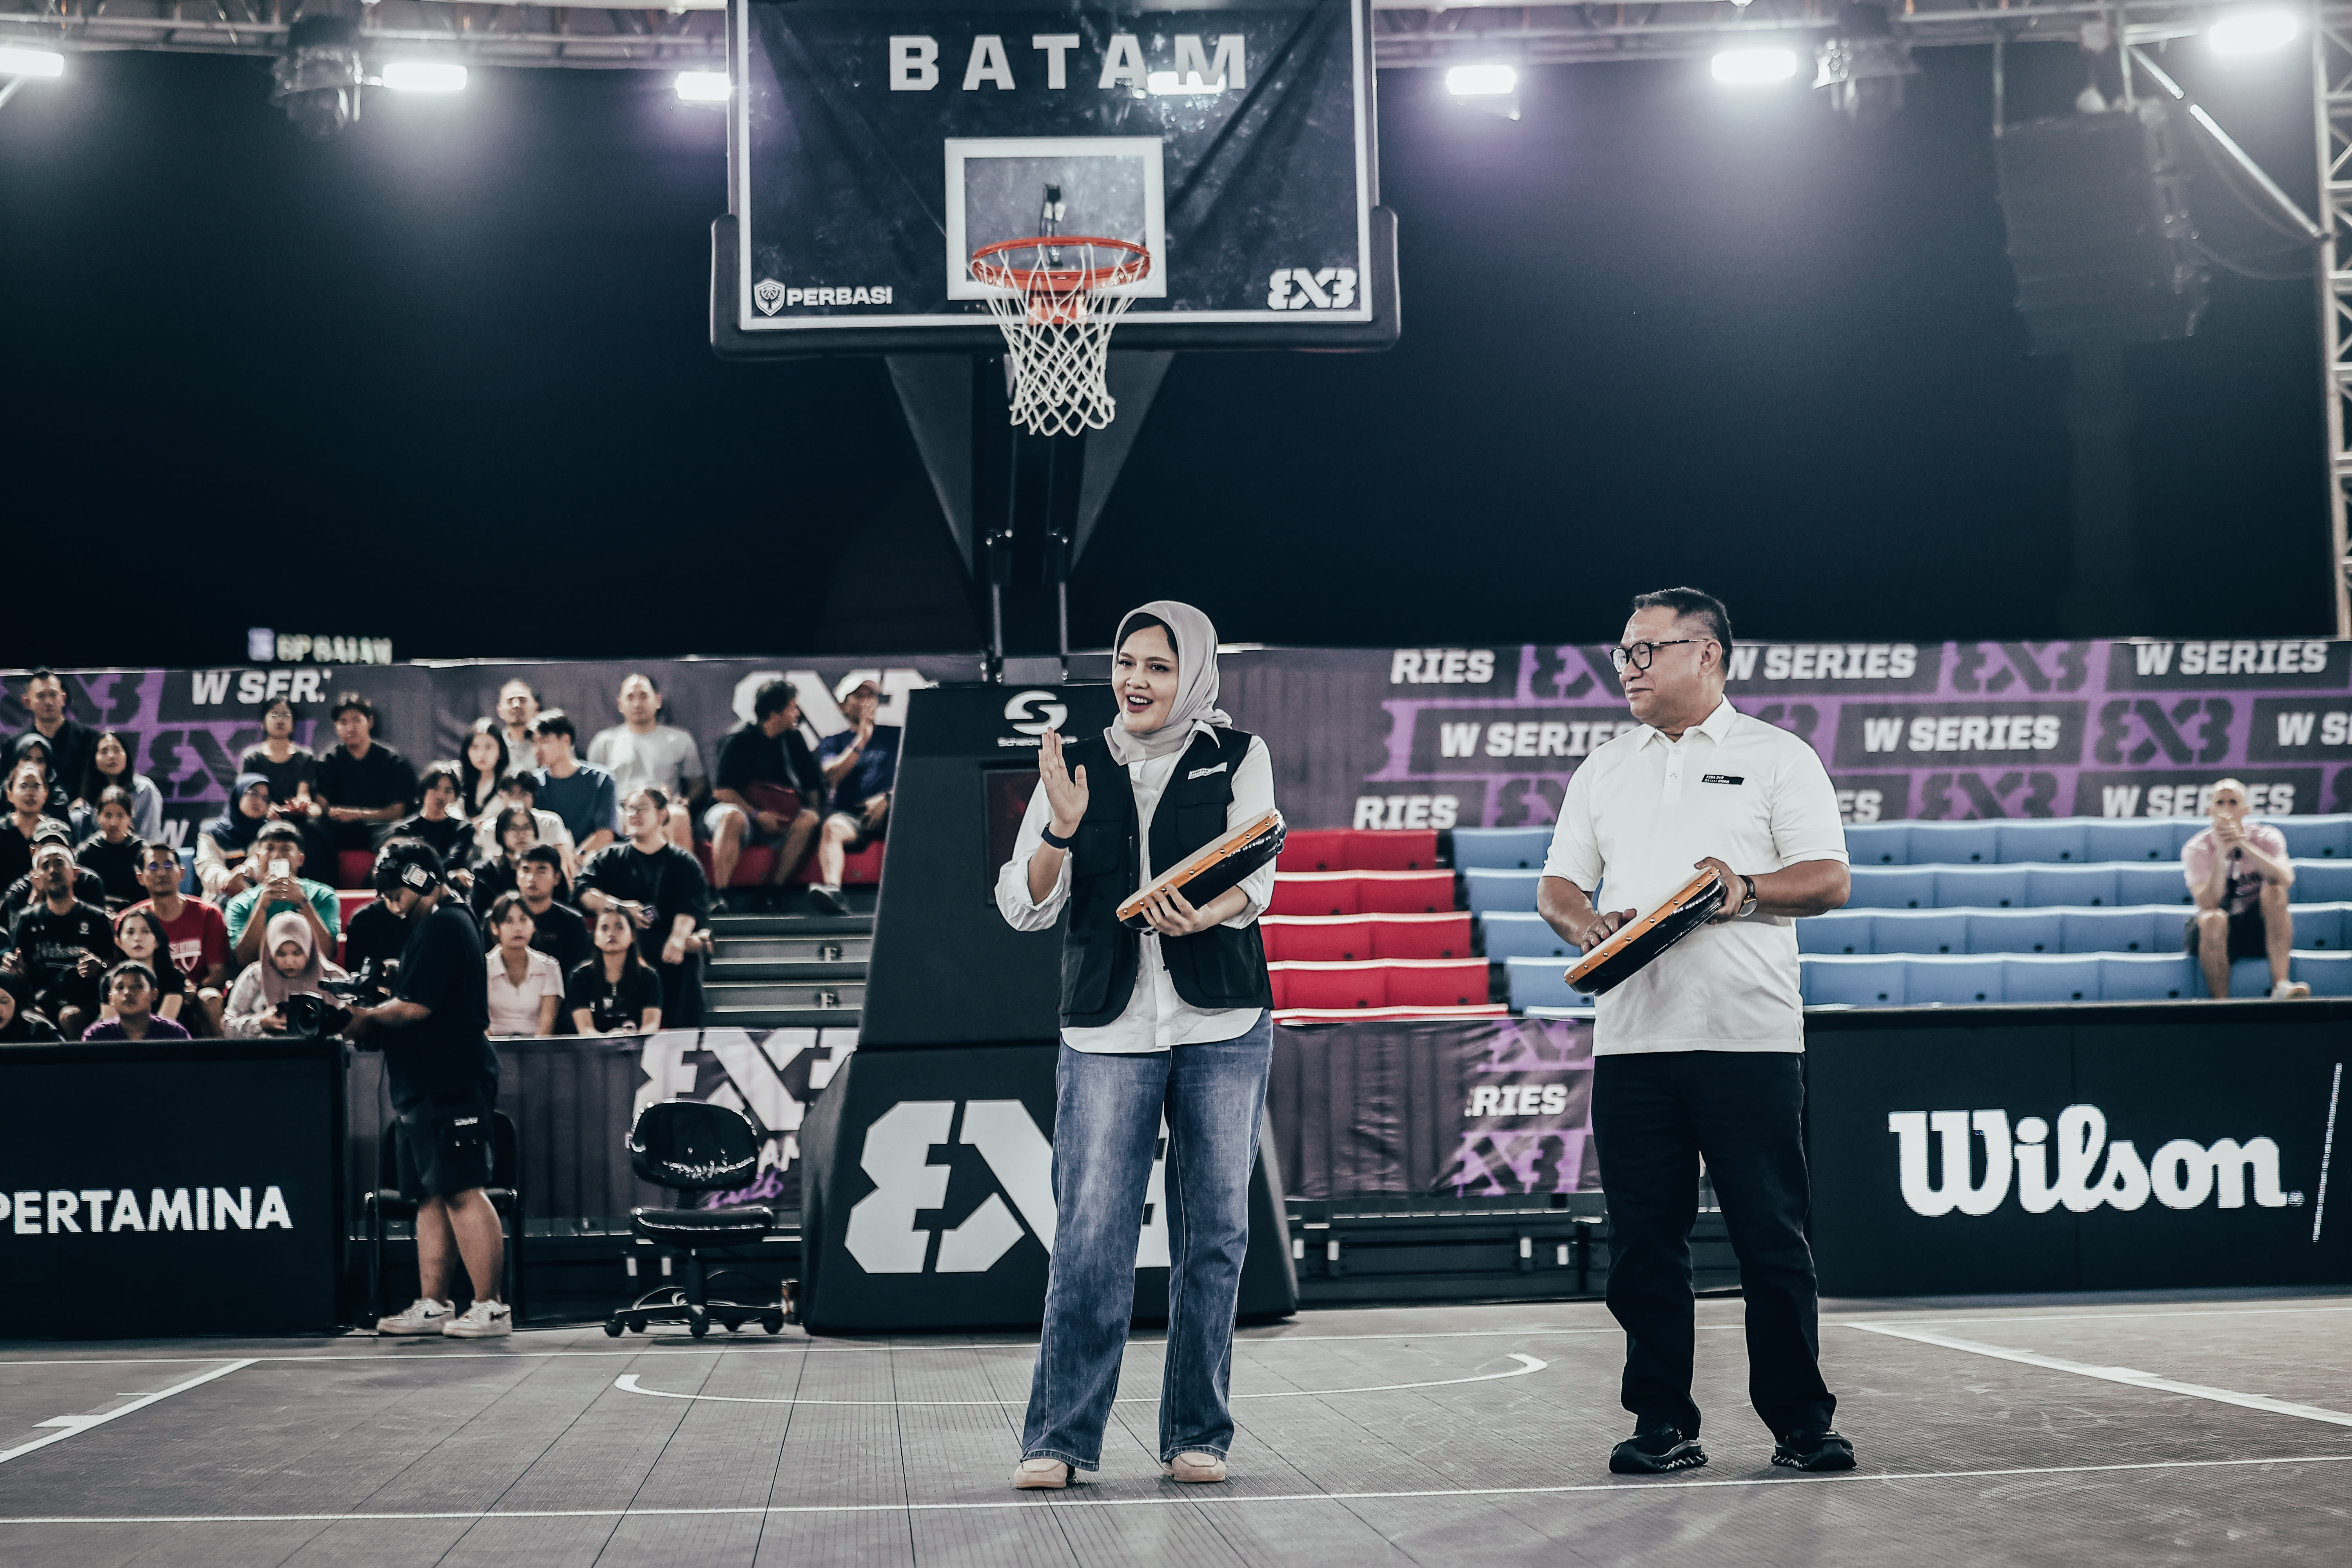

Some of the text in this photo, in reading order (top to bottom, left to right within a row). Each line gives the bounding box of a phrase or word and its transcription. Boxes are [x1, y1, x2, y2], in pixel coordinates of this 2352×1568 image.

[889, 33, 1247, 92] BATAM
[786, 285, 895, 307] PERBASI
[1762, 644, 1918, 680] SERIES
[2136, 643, 2327, 675] W SERIES
[192, 672, 231, 705] W
[1440, 720, 1635, 758] W SERIE
[1864, 715, 2061, 753] W SERIES
[2278, 713, 2315, 746] W
[2102, 786, 2141, 816] W
